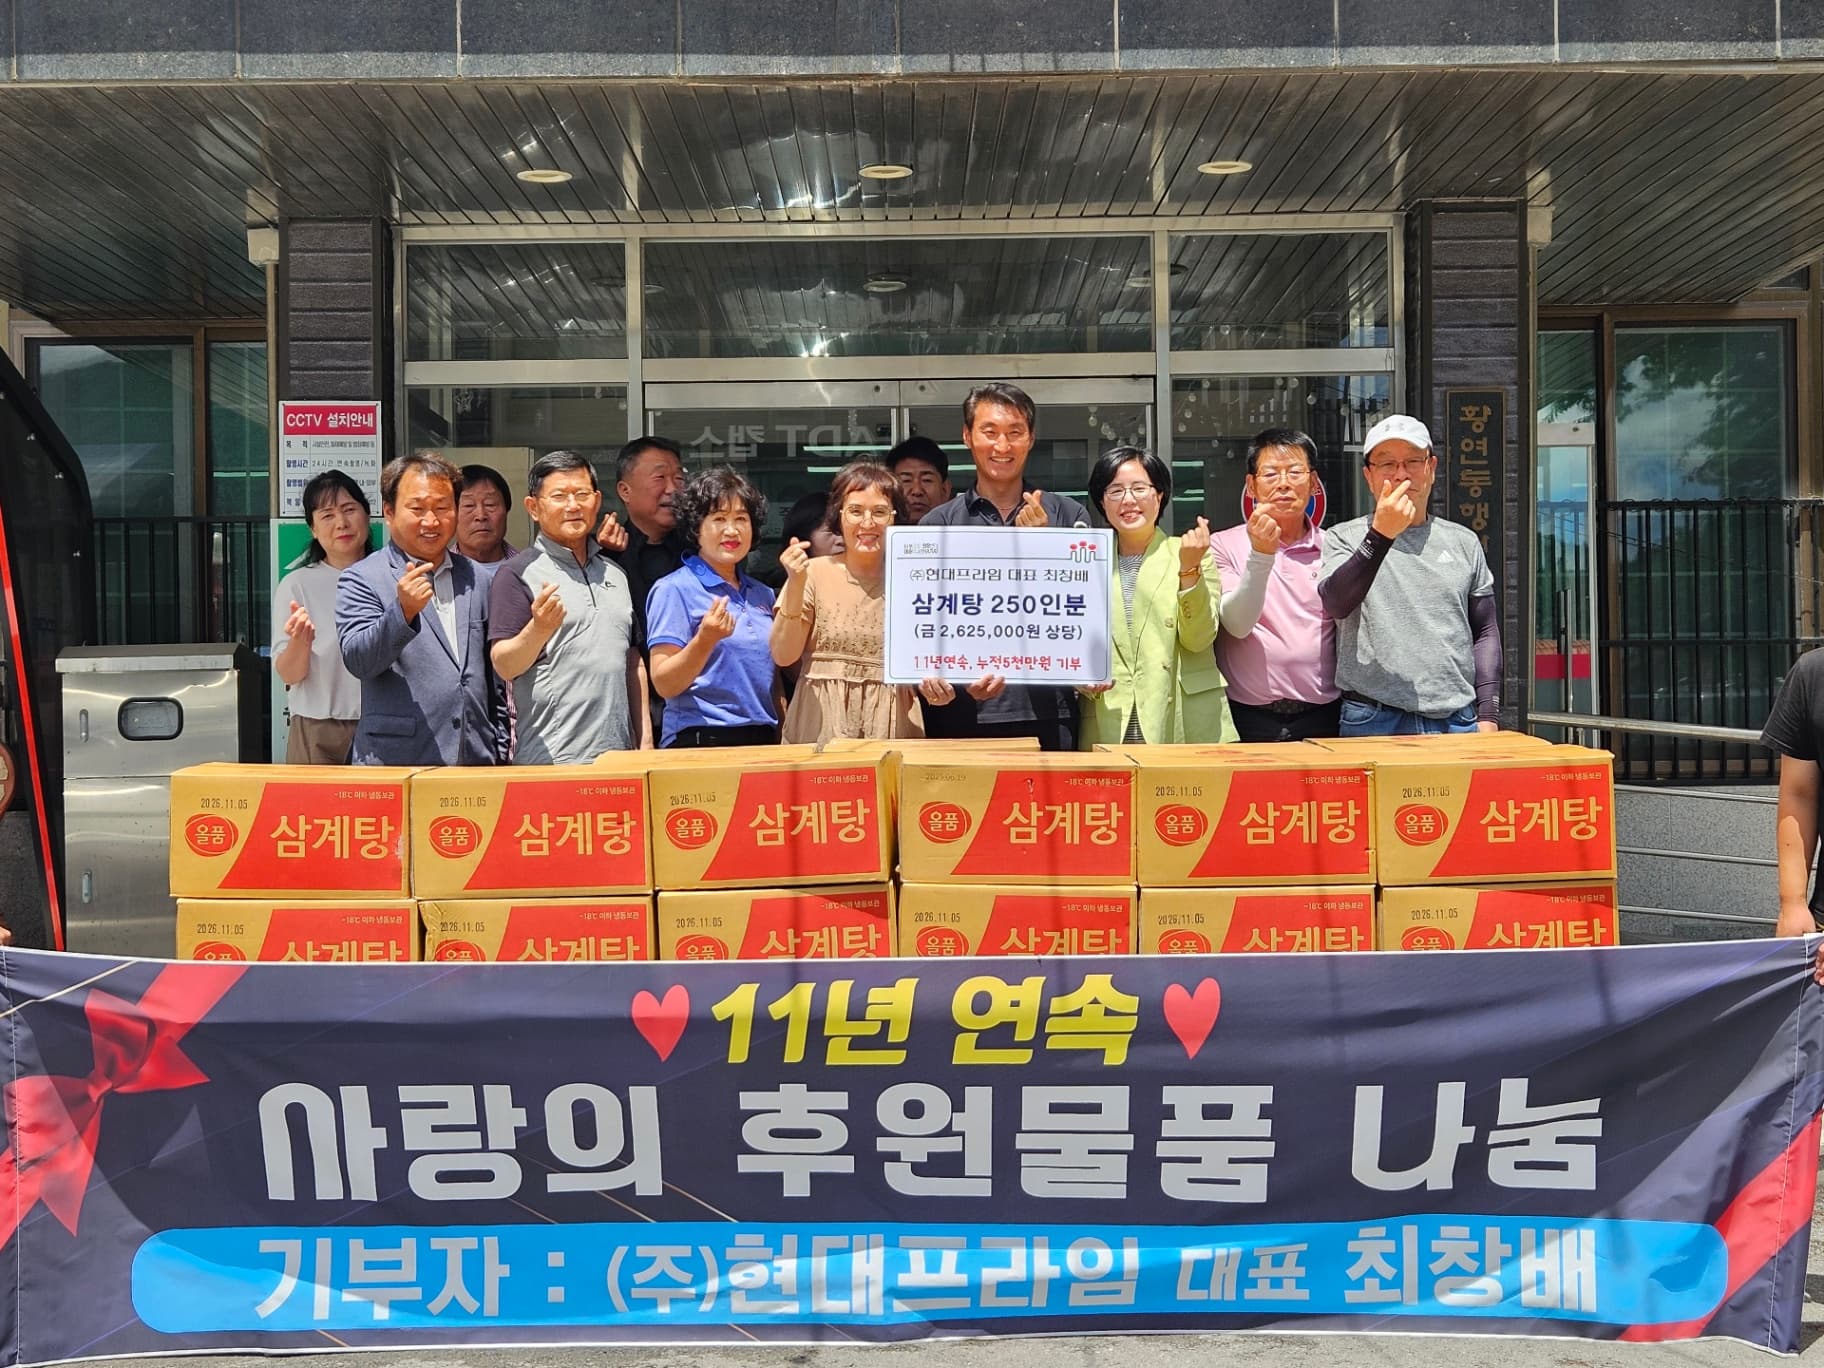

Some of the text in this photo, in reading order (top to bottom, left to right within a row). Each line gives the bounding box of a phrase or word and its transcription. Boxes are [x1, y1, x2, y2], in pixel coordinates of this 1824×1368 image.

[286, 412, 374, 428] CCTV 설치안내
[1459, 404, 1493, 553] 황연동행
[1008, 568, 1037, 582] 대표
[1043, 569, 1089, 583] 최창배
[912, 592, 1087, 617] 삼계탕 250인분
[1046, 624, 1083, 641] 상당)
[977, 655, 1051, 671] 누적5천만원
[1056, 656, 1082, 671] 기부
[828, 775, 842, 784] 이하
[1084, 778, 1098, 786] 이하
[1320, 776, 1333, 784] 이하
[1561, 773, 1574, 781] 이하
[354, 791, 367, 800] 이하
[595, 787, 608, 795] 이하
[1155, 785, 1203, 797] 2026.11.05
[1402, 787, 1450, 799] 2026.11.05
[200, 798, 248, 809] 2026.11.05
[440, 796, 486, 808] 2026.11.05
[675, 817, 706, 838] 올품
[748, 798, 871, 847] 삼계탕
[928, 811, 960, 832] 올품
[1002, 801, 1124, 846] 삼계탕
[1164, 814, 1195, 835] 올품
[1239, 799, 1362, 845] 삼계탕
[1404, 813, 1435, 834] 올품
[1479, 796, 1603, 843] 삼계탕
[195, 824, 227, 845] 올품
[270, 815, 395, 860] 삼계탕
[439, 825, 470, 846] 올품
[513, 810, 637, 857] 삼계탕
[1082, 904, 1096, 912] 이하
[1323, 902, 1336, 910] 이하
[1411, 908, 1458, 920] 2026.11.05
[361, 915, 375, 924] 이하
[599, 911, 612, 920] 이하
[914, 911, 961, 923] 2026.11.05
[197, 923, 244, 935] 2026.11.05
[440, 921, 485, 932] 2026.11.05
[925, 936, 956, 956] 올품
[711, 974, 1140, 1066] 11년 연속
[257, 1077, 1603, 1204] 사랑의 후원물품 나눔
[255, 1225, 1598, 1322] 기부자 : (주)현대프라임 대표 최창배
